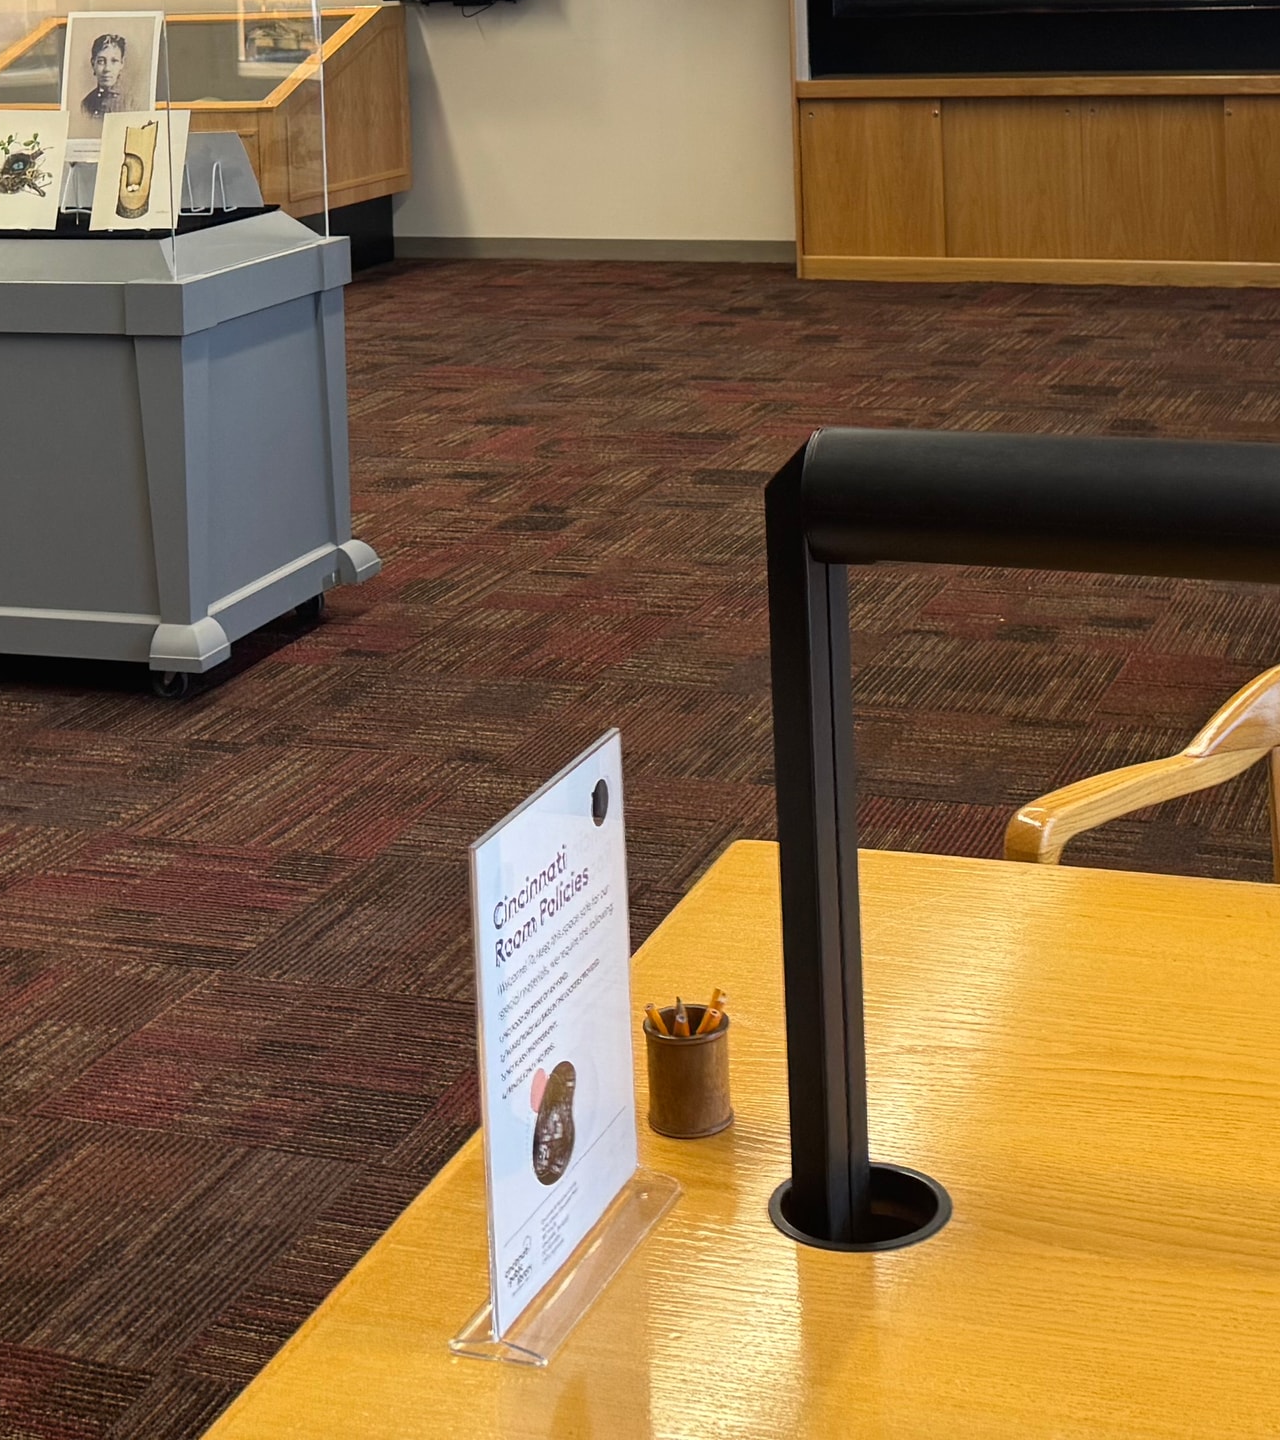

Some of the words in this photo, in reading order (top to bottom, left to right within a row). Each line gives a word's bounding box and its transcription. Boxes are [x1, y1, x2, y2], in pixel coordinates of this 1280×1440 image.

[493, 844, 568, 930] Cincinnati
[495, 916, 538, 968] Room
[539, 866, 589, 926] Policies
